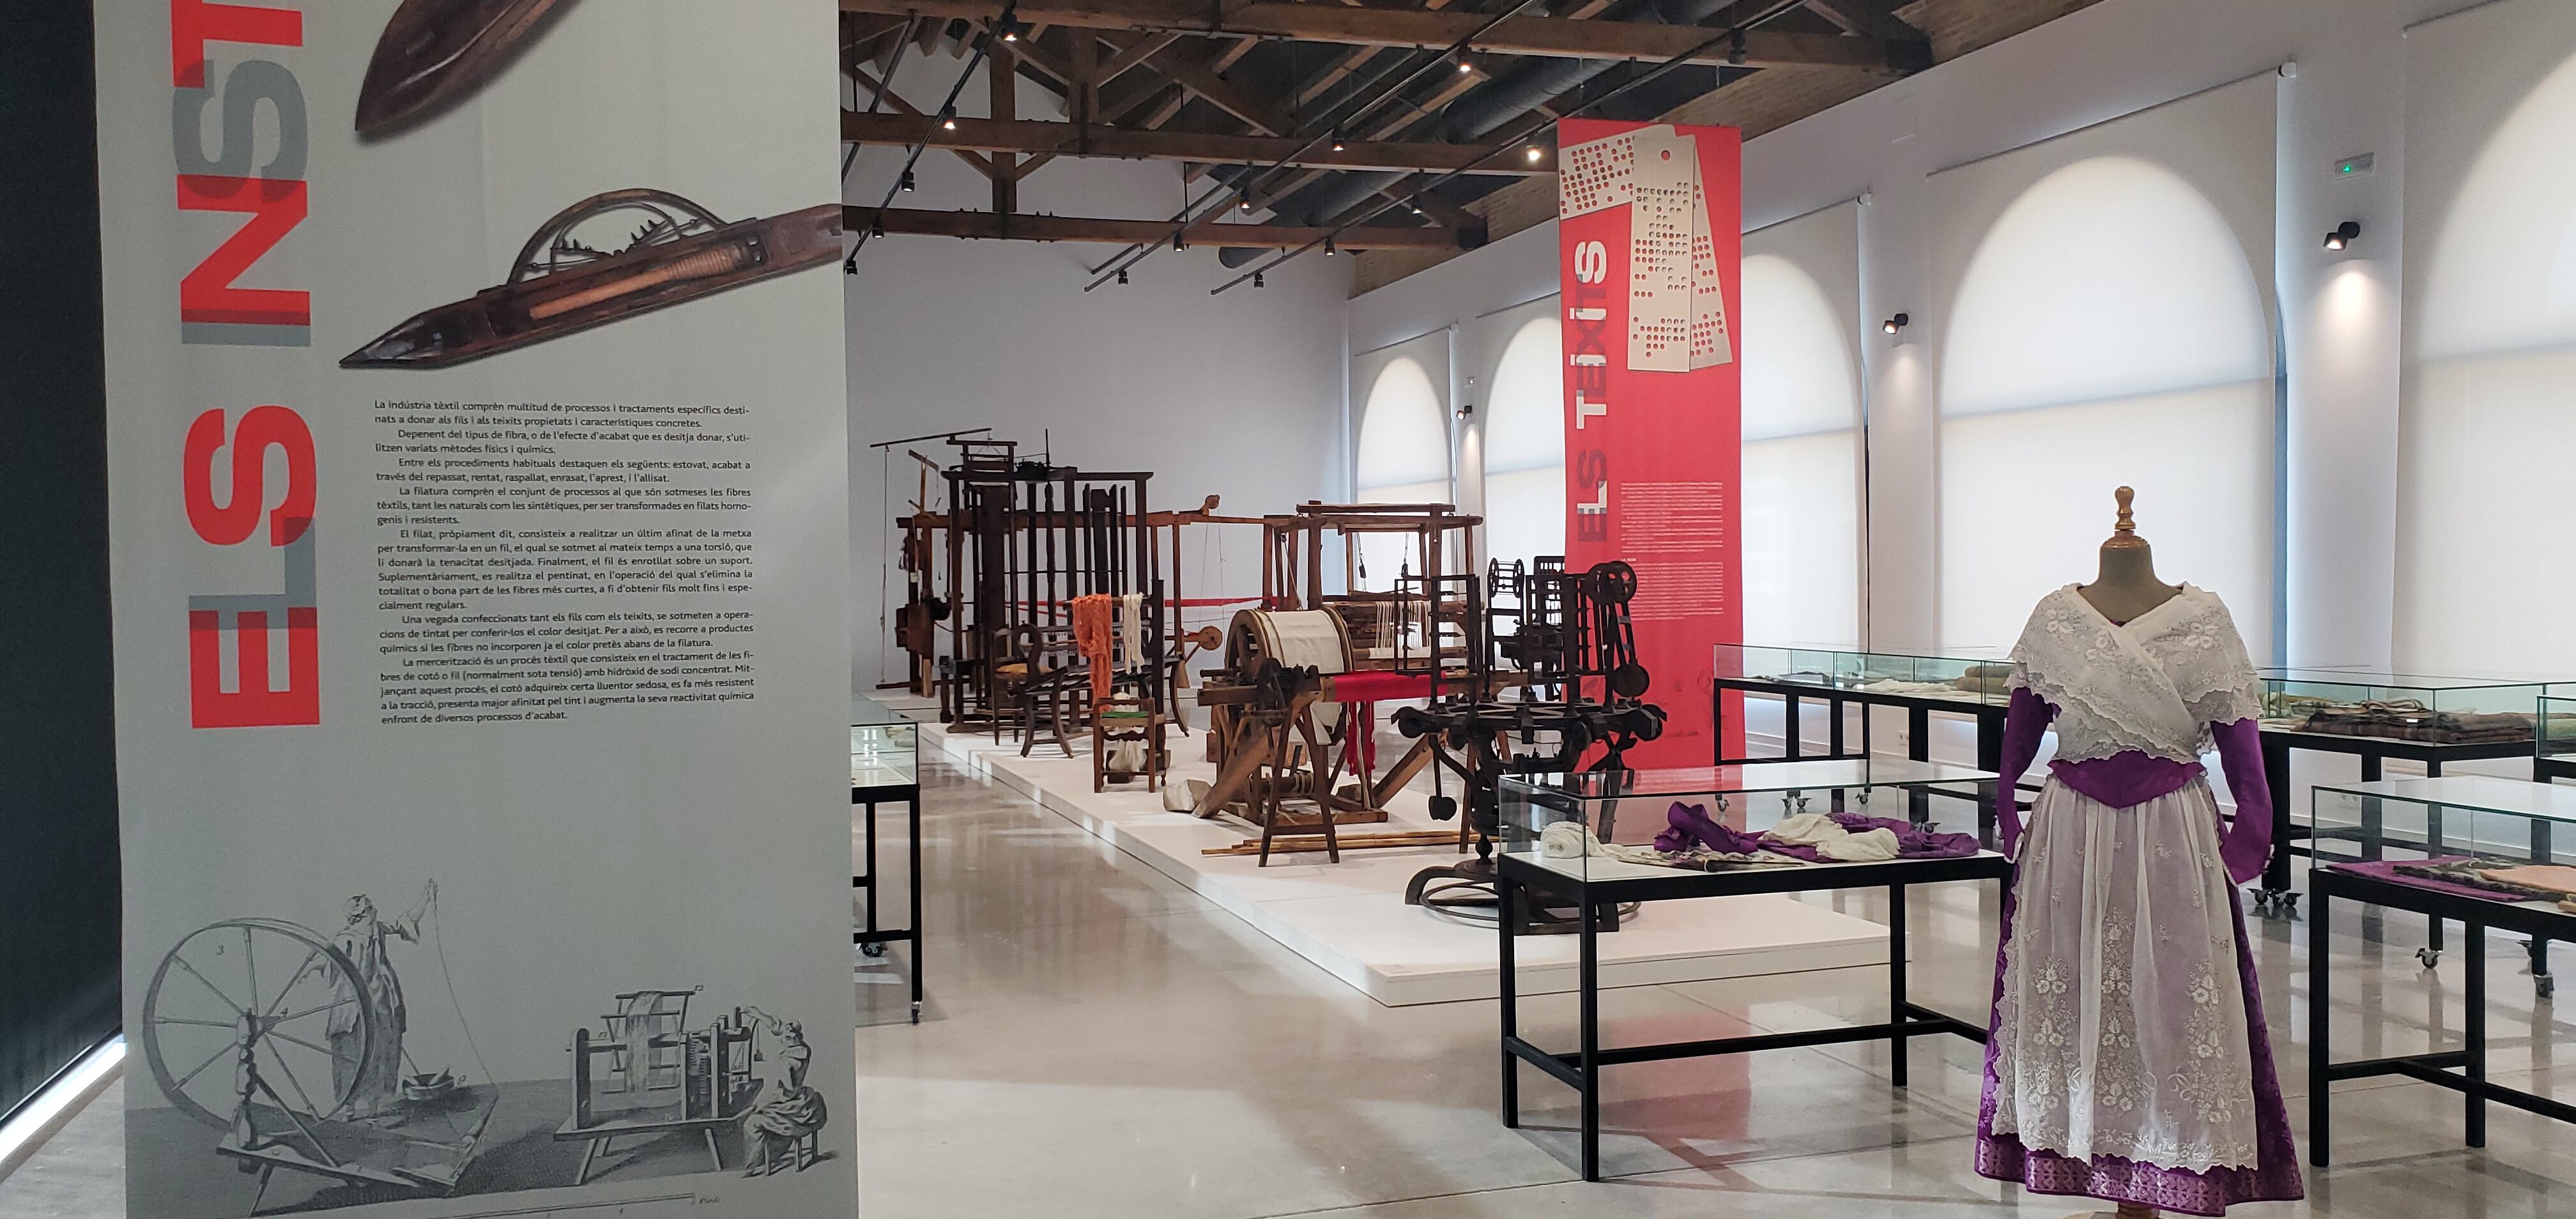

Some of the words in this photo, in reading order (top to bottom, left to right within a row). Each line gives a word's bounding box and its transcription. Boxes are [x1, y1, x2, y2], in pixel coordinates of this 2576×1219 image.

[374, 399, 385, 408] La
[388, 400, 431, 410] indústria
[434, 401, 459, 410] tèxtil
[461, 401, 504, 413] comprèn
[507, 402, 548, 411] multitud
[550, 402, 562, 411] de
[564, 404, 611, 415] processos
[723, 406, 749, 414] desti-
[407, 415, 436, 424] donar
[438, 415, 451, 424] als
[454, 415, 468, 424] fils
[476, 415, 490, 424] als
[492, 416, 522, 425] teixits
[524, 417, 572, 427] propietats
[397, 429, 445, 440] Depenent
[447, 429, 462, 438] del
[464, 430, 489, 440] tipus
[491, 430, 502, 439] de
[505, 430, 529, 440] fibra,
[539, 430, 551, 439] de
[632, 434, 649, 442] que
[664, 432, 694, 443] desitja
[696, 432, 724, 442] donar,
[374, 443, 402, 452] litzen
[405, 443, 437, 452] variats
[440, 443, 482, 453] mètodes
[398, 458, 424, 466] Entre
[427, 457, 441, 466] els
[444, 458, 509, 470] procediments
[512, 458, 556, 467] habituals
[559, 458, 608, 470] destaquen
[611, 459, 624, 468] els
[673, 461, 709, 470] estovat,
[711, 460, 742, 469] acabat
[376, 472, 406, 480] través
[408, 471, 423, 480] del
[425, 473, 469, 483] repassat,
[471, 473, 503, 482] rentat,
[505, 473, 548, 484] raspallat,
[549, 474, 587, 482] enrasat,
[1577, 448, 1607, 542] ELS
[376, 500, 410, 510] tèxtils,
[433, 500, 447, 509] les
[448, 501, 487, 509] naturals
[512, 501, 526, 510] les
[526, 501, 581, 512] sintètiques,
[583, 503, 598, 512] per
[615, 501, 681, 510] transformades
[696, 501, 719, 509] filats
[721, 501, 751, 510] homo-
[377, 515, 402, 526] genis
[411, 515, 460, 523] resistents.
[183, 405, 320, 728] ELS
[378, 558, 383, 567] li
[388, 557, 422, 567] donarà
[426, 558, 435, 566] la
[440, 558, 484, 567] tenacitat
[487, 557, 534, 569] desitjada.
[537, 556, 588, 566] Finalment,
[592, 556, 600, 565] el
[604, 556, 613, 565] fil
[617, 556, 627, 565] és
[631, 556, 672, 565] enrotllat
[675, 556, 701, 564] sobre
[719, 556, 753, 567] suport.
[495, 571, 532, 580] realitza
[535, 571, 544, 579] el
[547, 571, 590, 581] pentinat,
[658, 570, 673, 578] del
[676, 570, 696, 581] qual
[744, 569, 753, 578] la
[378, 601, 422, 610] cialment
[420, 643, 428, 652] si
[431, 643, 444, 652] les
[447, 643, 473, 652] fibres
[491, 641, 541, 653] incorporen
[544, 641, 553, 652] ja
[555, 640, 564, 649] el
[566, 640, 590, 649] color
[592, 640, 622, 650] pretès
[624, 639, 651, 648] abans
[653, 638, 664, 647] de
[667, 638, 675, 647] la
[677, 638, 713, 647] filatura.
[379, 671, 401, 681] bres
[402, 671, 415, 680] de
[417, 671, 440, 680] cotó
[450, 671, 460, 679] fil
[463, 669, 525, 681] (normalment
[549, 668, 581, 679] tensió)
[584, 667, 605, 676] amb
[607, 666, 645, 676] hidròxid
[647, 666, 659, 675] de
[659, 666, 678, 675] sodi
[735, 664, 754, 672] Mit-
[381, 714, 418, 724] enfront
[420, 714, 432, 723] de
[434, 712, 474, 722] diversos
[477, 714, 523, 723] processos
